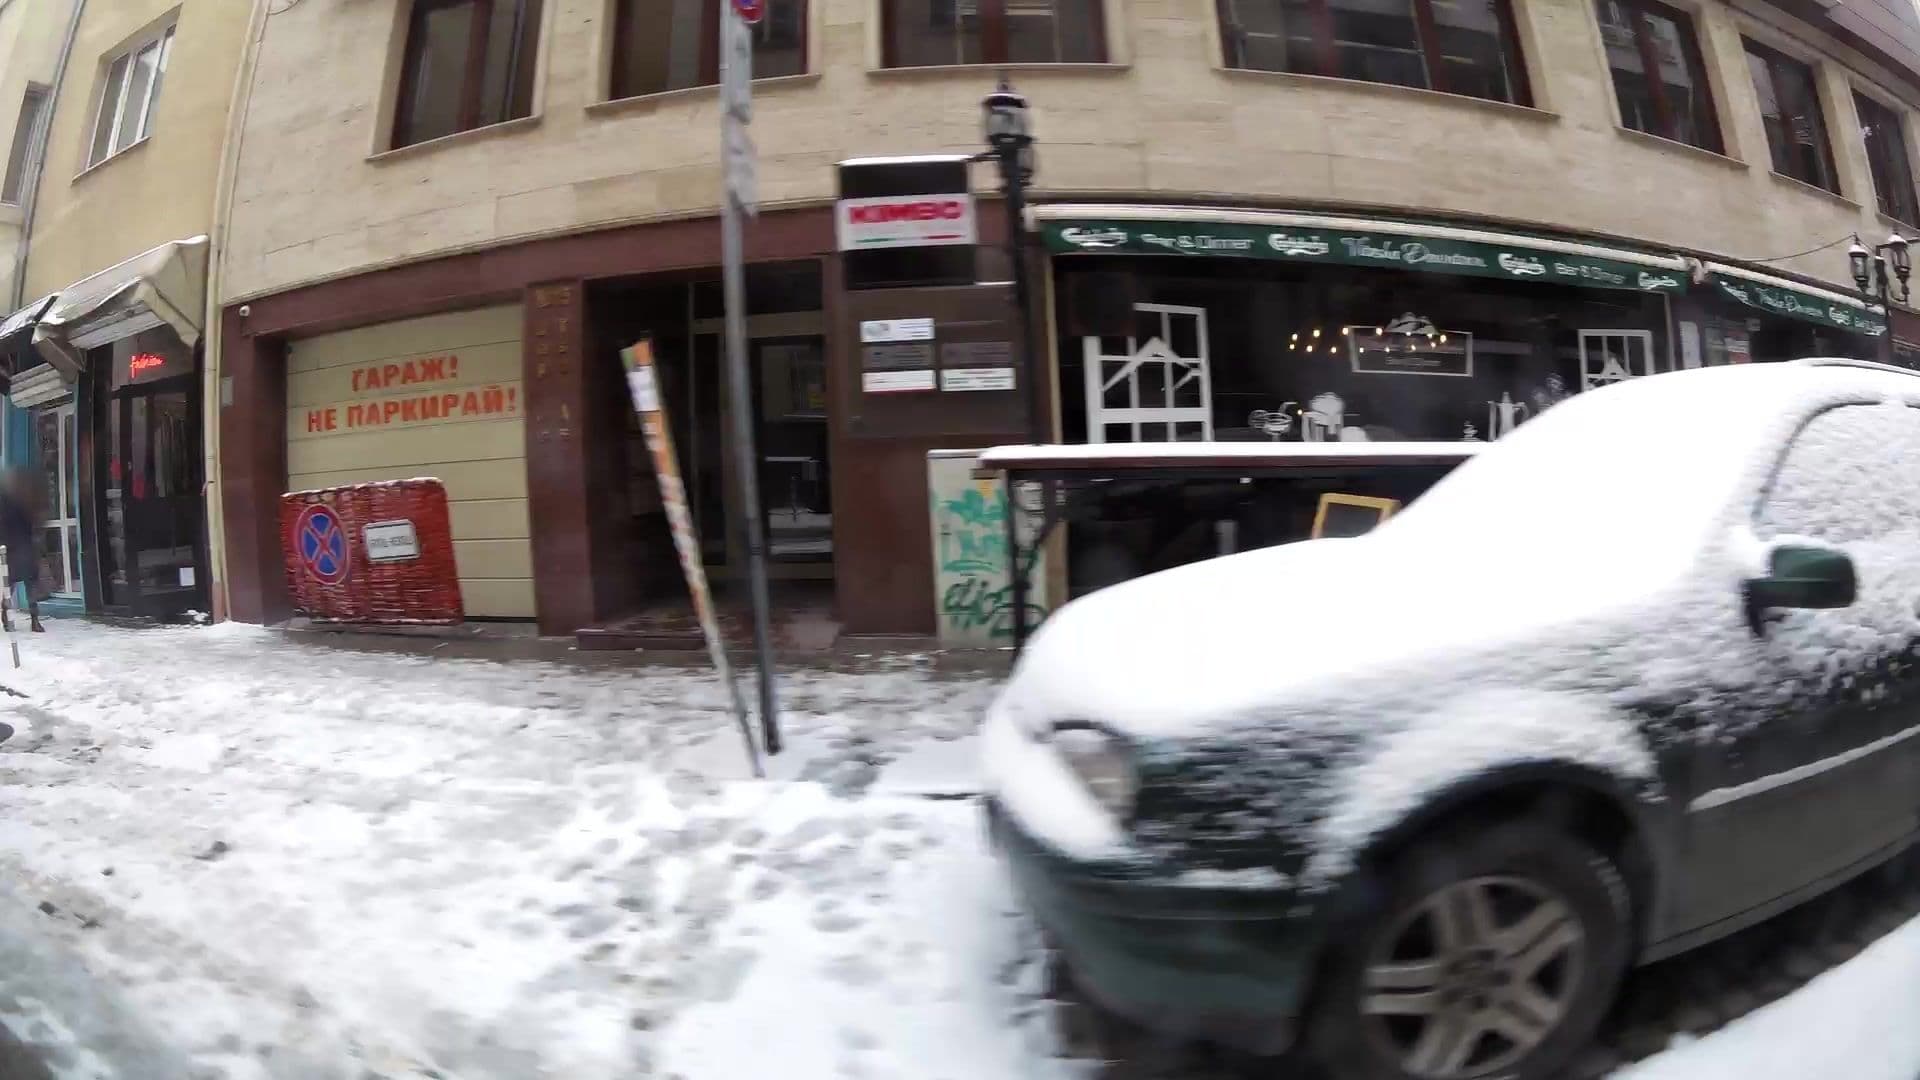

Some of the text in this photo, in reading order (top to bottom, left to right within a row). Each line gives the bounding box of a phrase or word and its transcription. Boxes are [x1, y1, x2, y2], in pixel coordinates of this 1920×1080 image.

[351, 355, 458, 392] ГАРАЖ!
[307, 409, 338, 432] НЕ
[347, 386, 516, 428] ПАРКИРАЙ!
